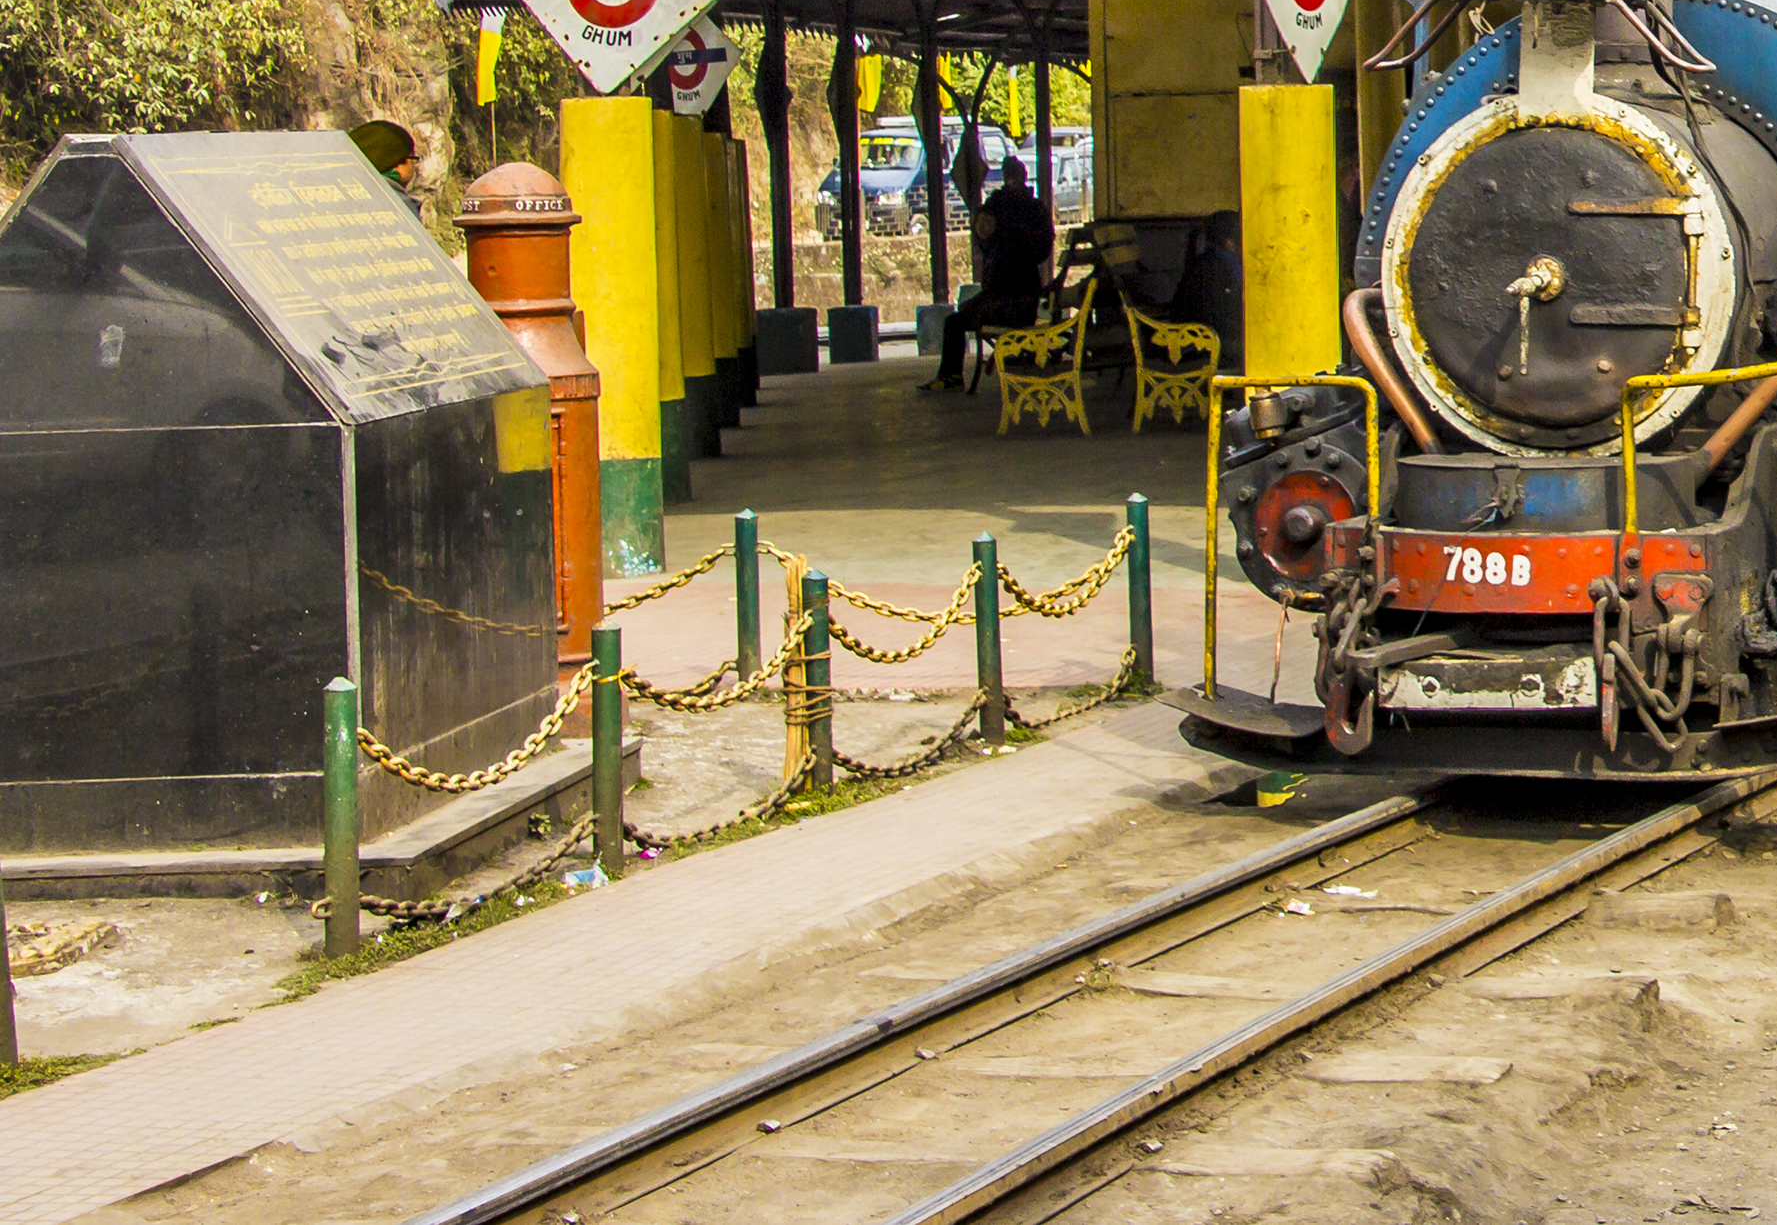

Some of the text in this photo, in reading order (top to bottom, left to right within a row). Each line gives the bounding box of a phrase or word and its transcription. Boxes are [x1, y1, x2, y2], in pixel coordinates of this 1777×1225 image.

[1295, 12, 1323, 30] GHUM
[581, 25, 633, 46] GHUM
[676, 89, 701, 102] GHUM
[515, 199, 564, 211] OFFICE
